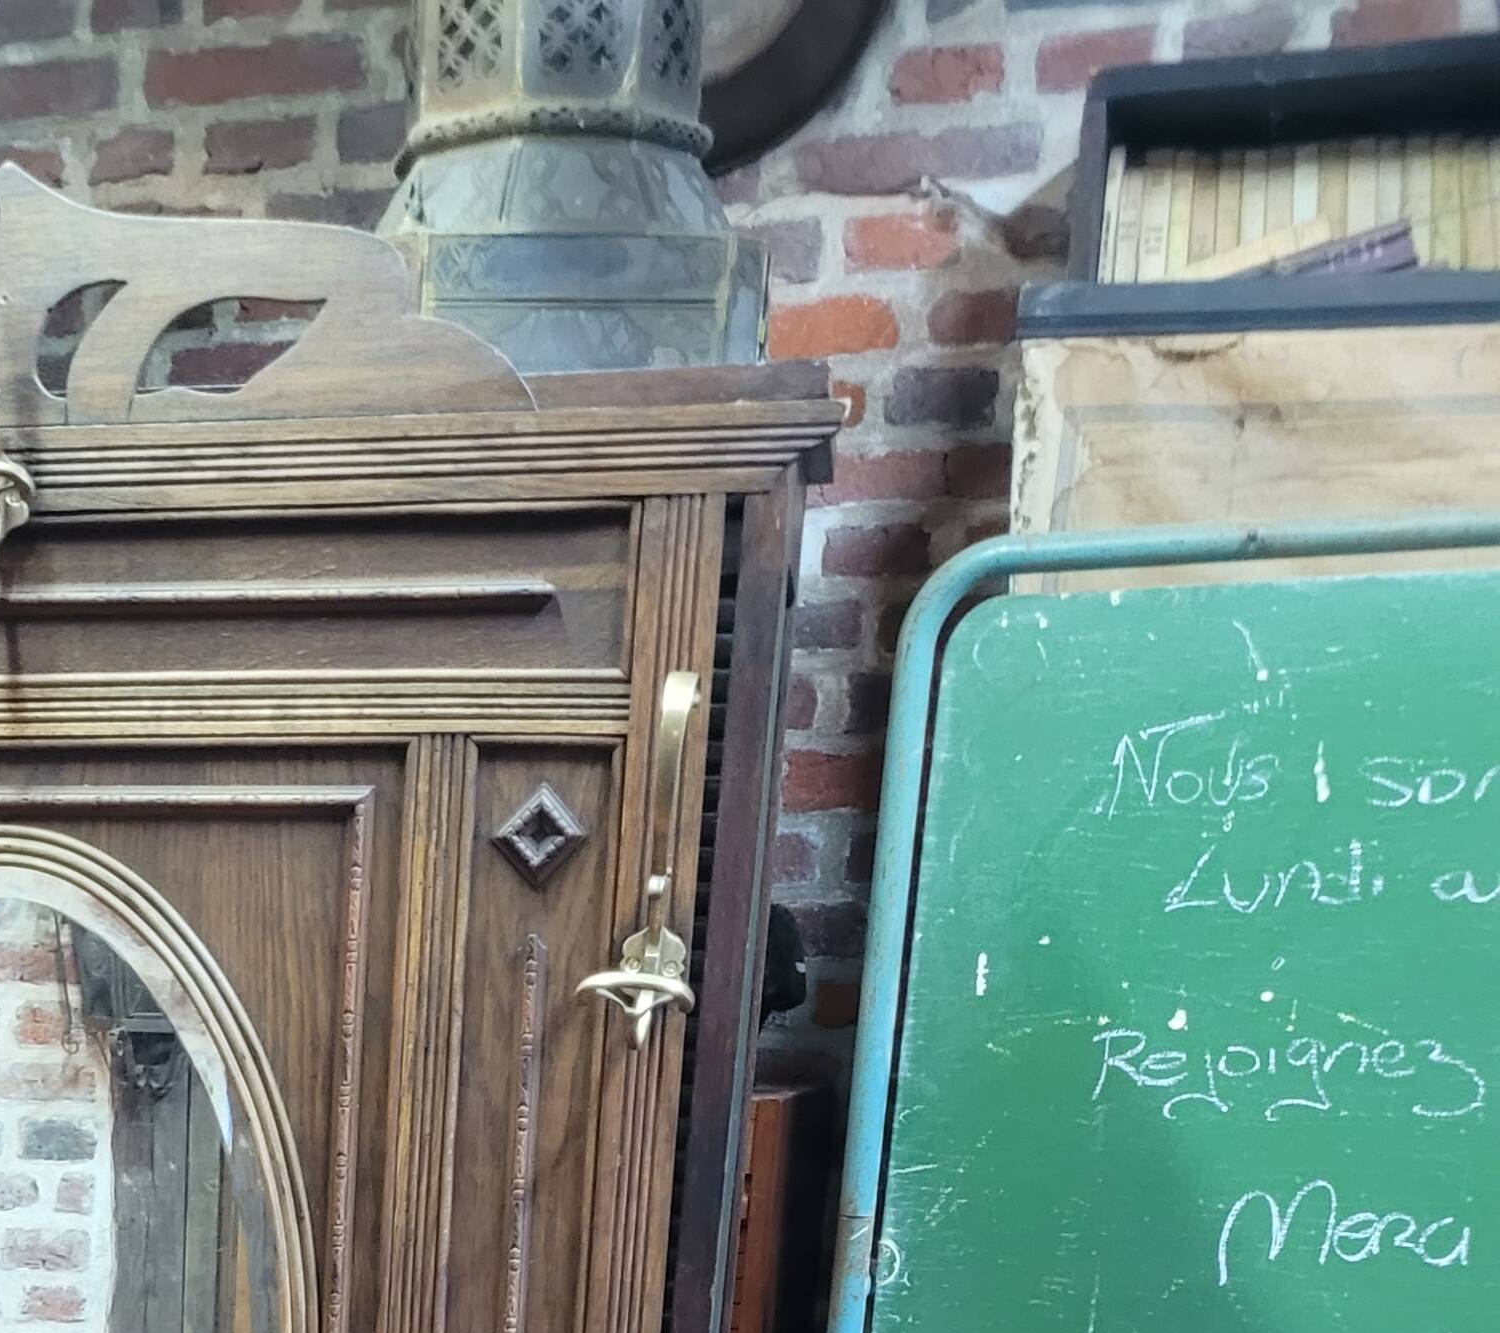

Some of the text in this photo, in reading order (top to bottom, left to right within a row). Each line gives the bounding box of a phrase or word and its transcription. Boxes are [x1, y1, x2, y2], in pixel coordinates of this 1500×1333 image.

[1108, 711, 1282, 821] Nous
[1164, 837, 1387, 913] Lundi
[1092, 1008, 1486, 1121] Rejoignez
[1217, 1178, 1471, 1287] Merci
